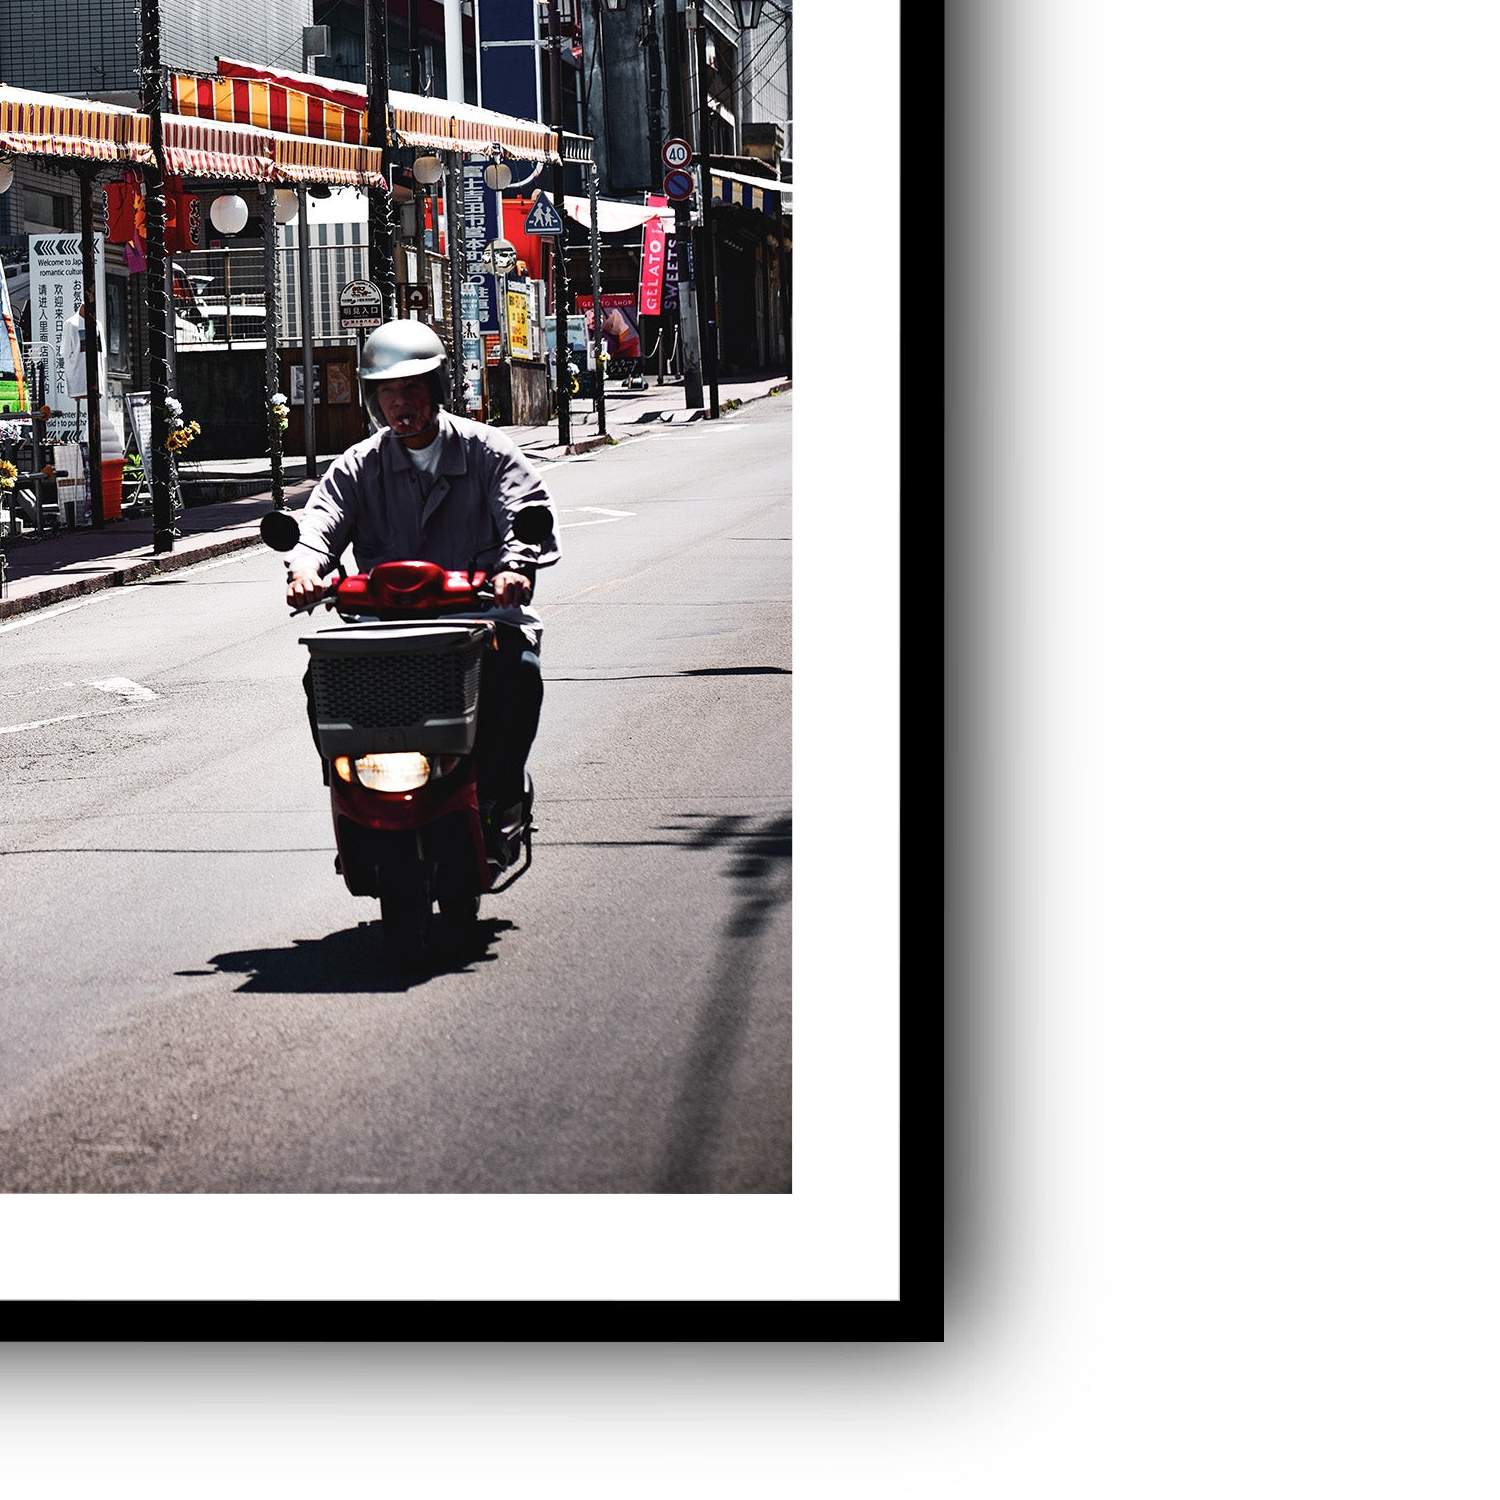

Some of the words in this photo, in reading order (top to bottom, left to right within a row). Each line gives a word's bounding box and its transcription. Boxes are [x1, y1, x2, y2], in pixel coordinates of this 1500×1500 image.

[669, 147, 685, 161] 40
[38, 258, 64, 267] Welcome
[65, 258, 71, 266] to
[65, 268, 84, 276] cultur
[646, 240, 662, 310] GELATO
